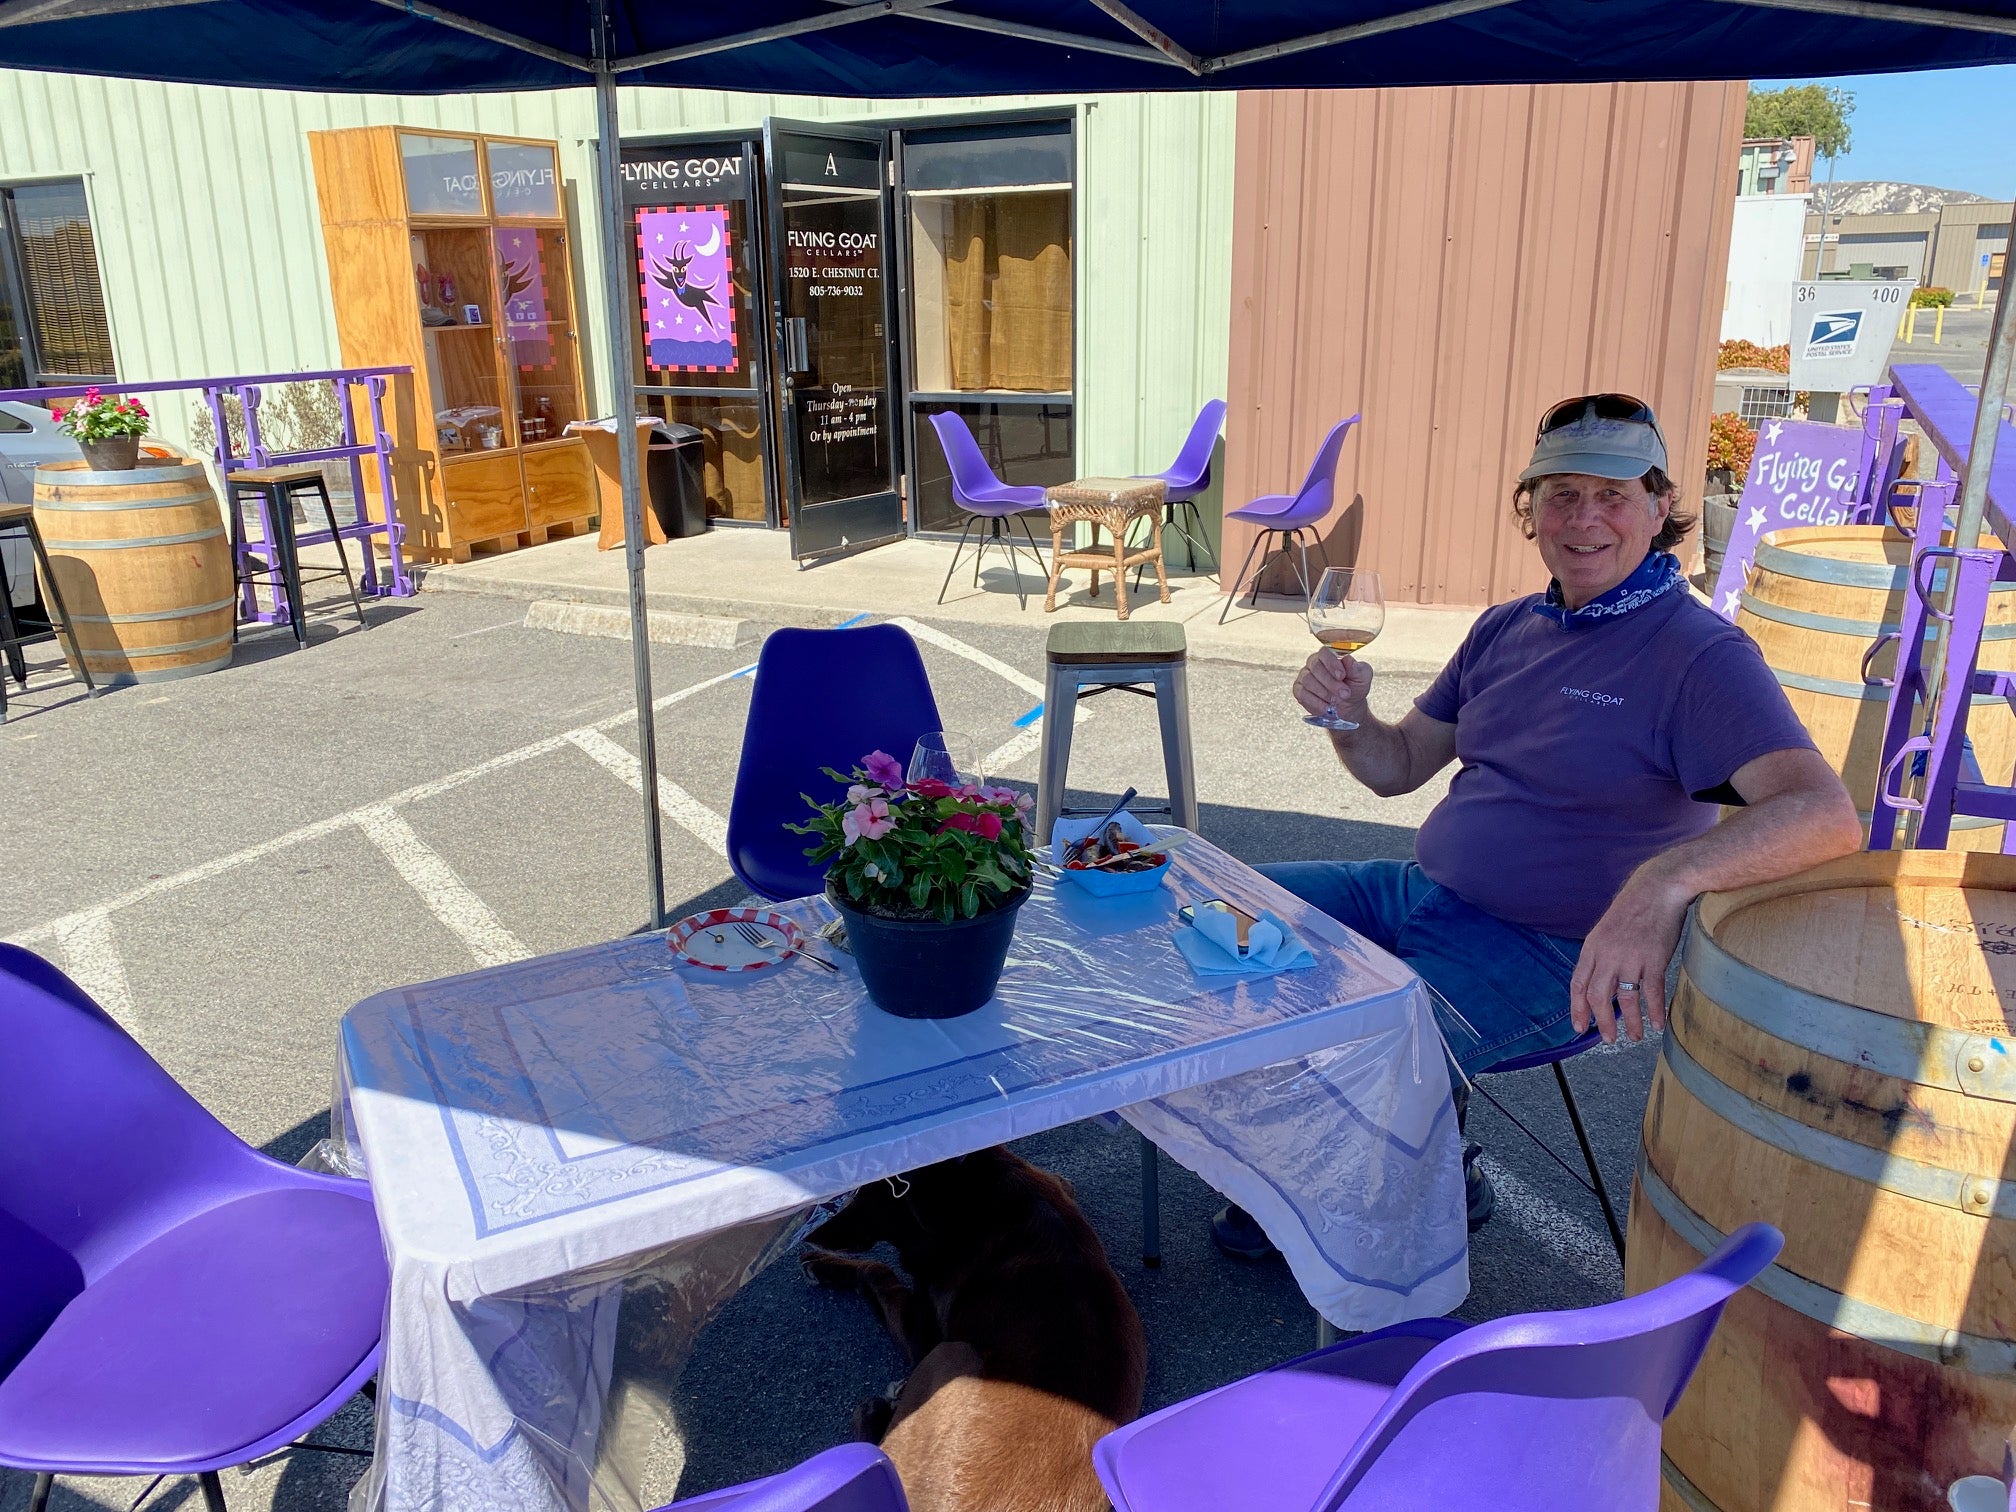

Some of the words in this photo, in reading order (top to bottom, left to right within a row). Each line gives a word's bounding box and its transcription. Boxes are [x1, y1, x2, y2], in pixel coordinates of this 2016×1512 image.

[684, 157, 742, 178] GOAT
[824, 152, 838, 176] A
[787, 230, 835, 248] FLYING
[838, 232, 878, 249] GOAT
[788, 267, 810, 278] 1520
[812, 267, 820, 278] E.
[822, 267, 866, 278] CHESTNUT
[867, 267, 880, 279] CT.
[809, 285, 864, 296] 805-736-9032
[1798, 286, 1816, 302] 36
[832, 382, 852, 396] Open
[820, 414, 829, 426] 11
[831, 416, 842, 425] am
[849, 412, 854, 423] 4
[855, 413, 867, 425] pm
[810, 430, 821, 442] Or
[822, 430, 832, 443] by
[833, 425, 877, 442] appointment
[1755, 451, 1823, 495] Flying
[1780, 492, 1854, 526] Cellar
[1560, 686, 1590, 698] FLYING
[1592, 692, 1625, 706] GOAT
